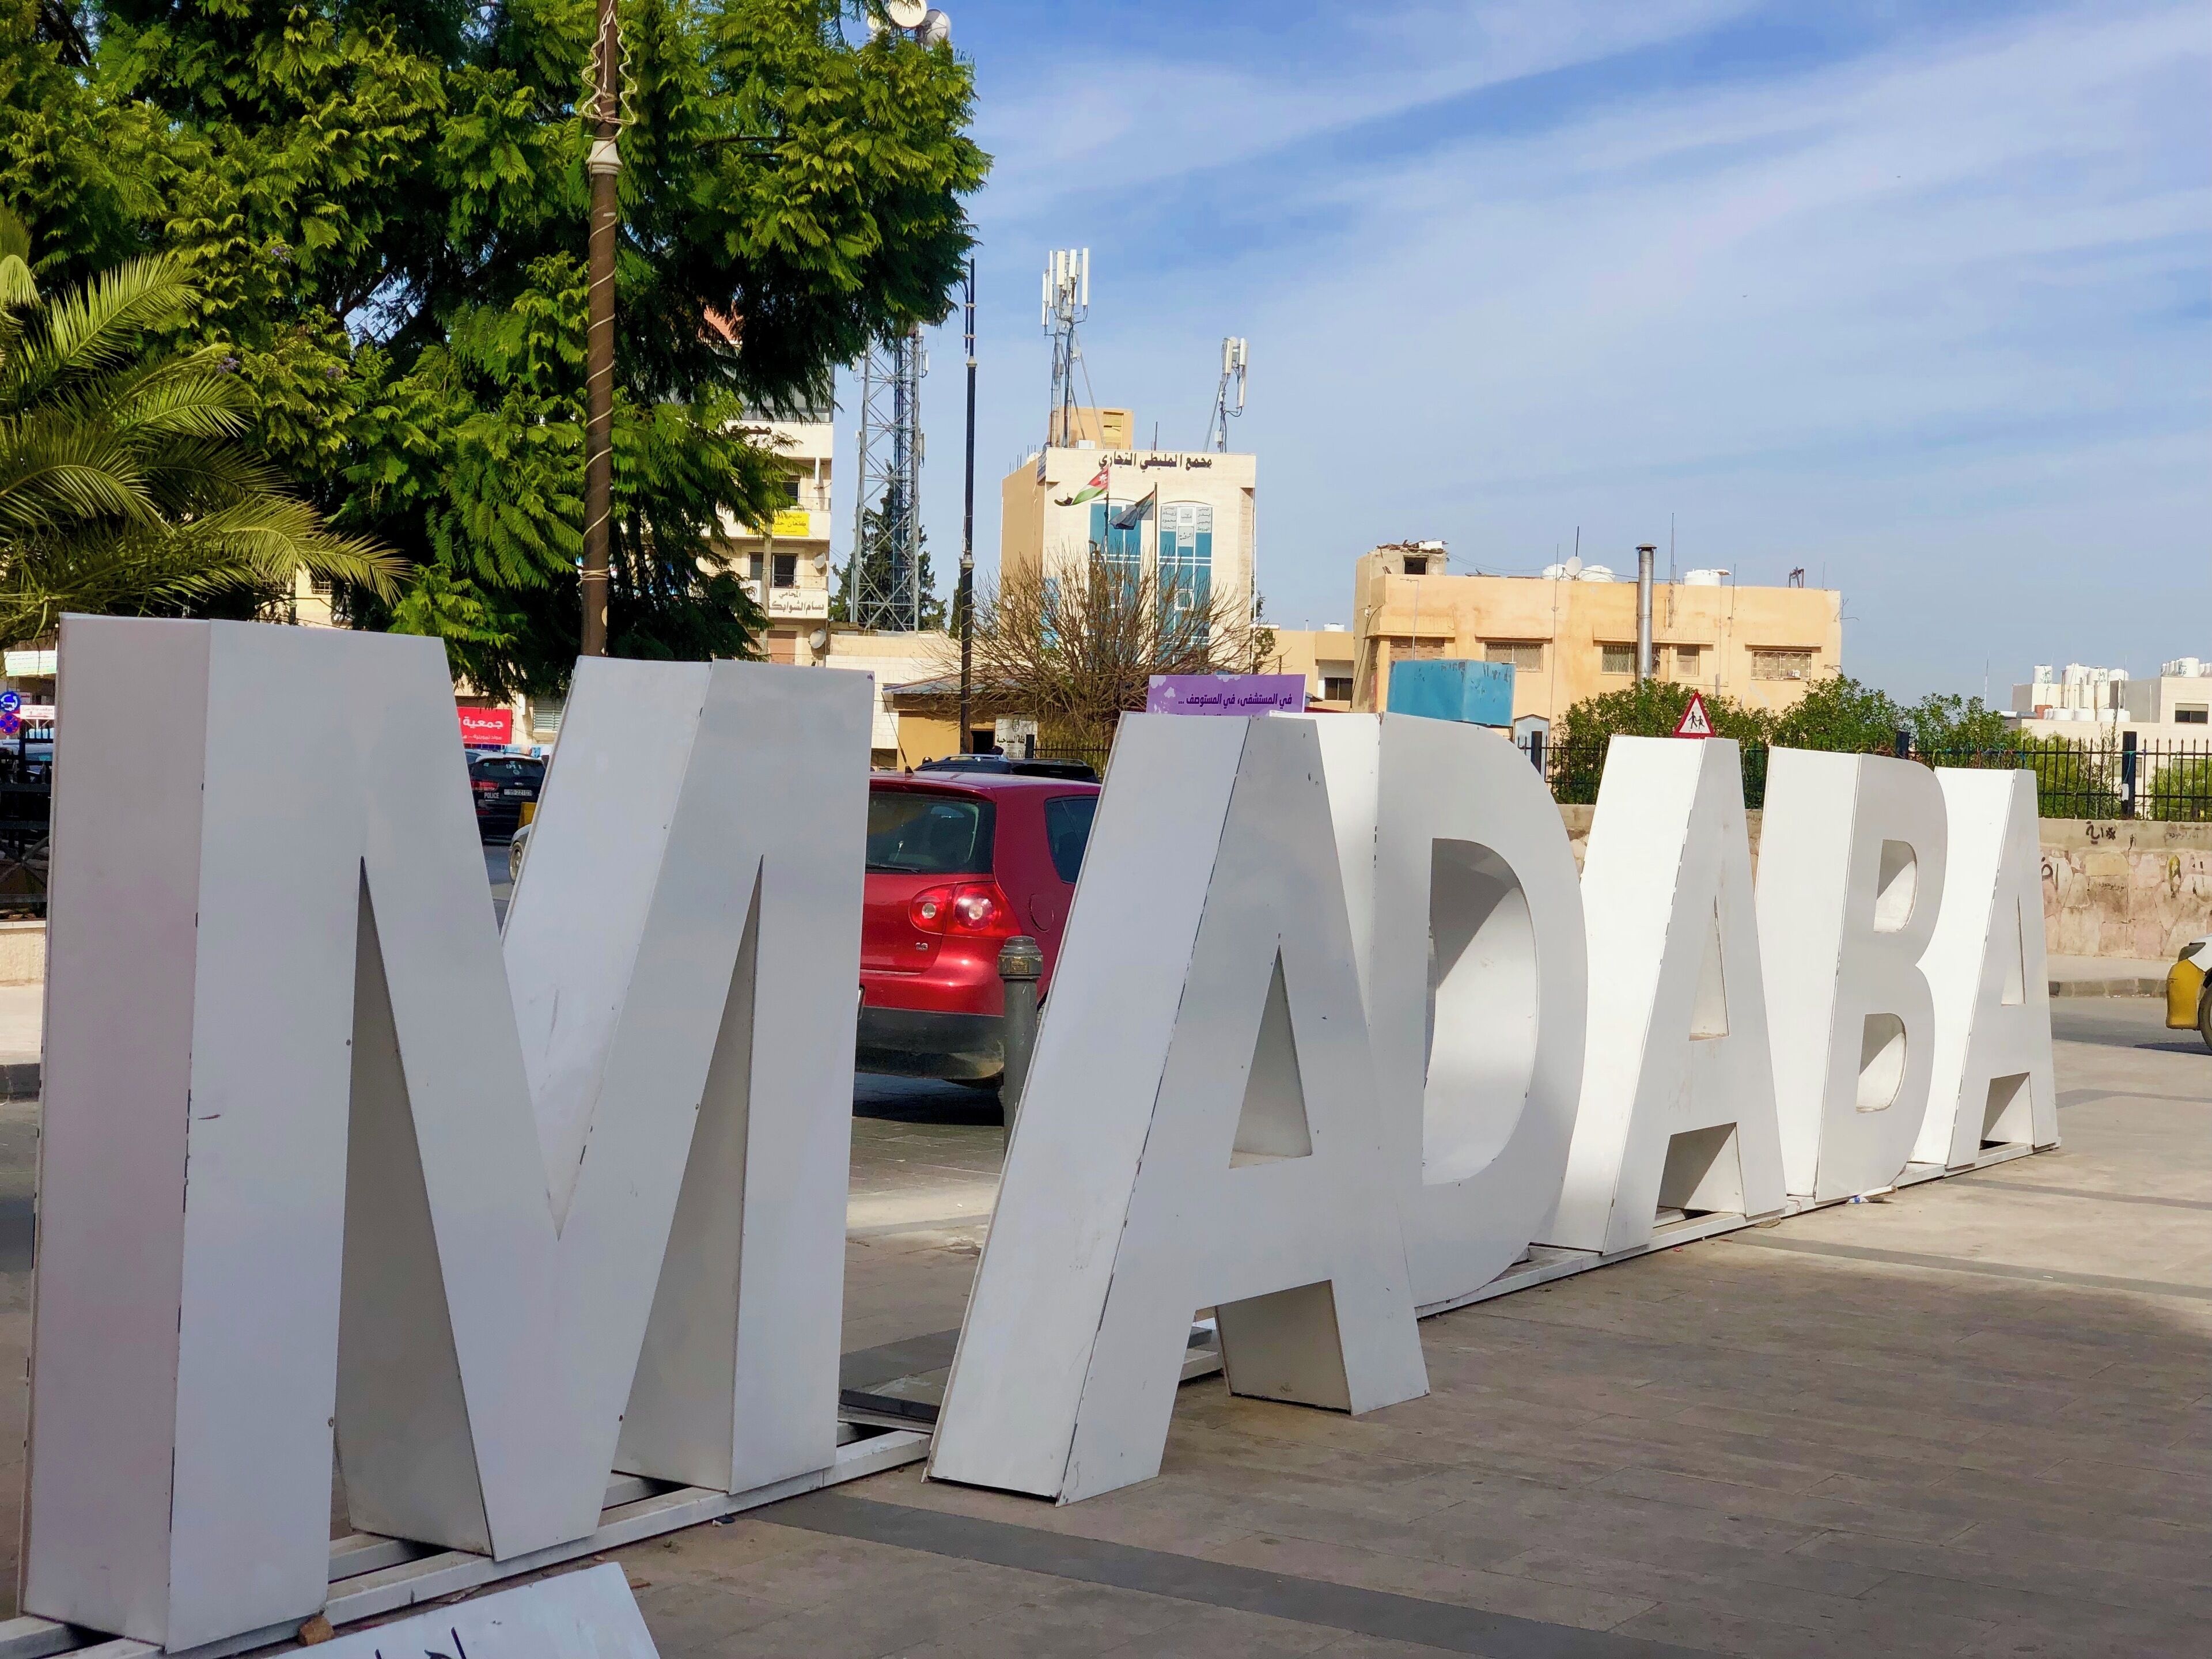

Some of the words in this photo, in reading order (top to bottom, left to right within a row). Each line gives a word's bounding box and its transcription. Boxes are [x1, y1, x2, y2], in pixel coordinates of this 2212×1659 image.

[1099, 450, 1137, 469] التجاري
[1185, 457, 1212, 471] مجمع
[779, 590, 801, 599] المحامي
[769, 600, 806, 613] الشوابك
[806, 601, 824, 616] بسام
[1186, 694, 1222, 707] المستوصف
[1224, 693, 1235, 709] في
[1238, 692, 1278, 707] المستشفى،
[1279, 693, 1292, 709] في
[463, 717, 503, 729] جمعية
[23, 612, 2060, 1653] MADABA
